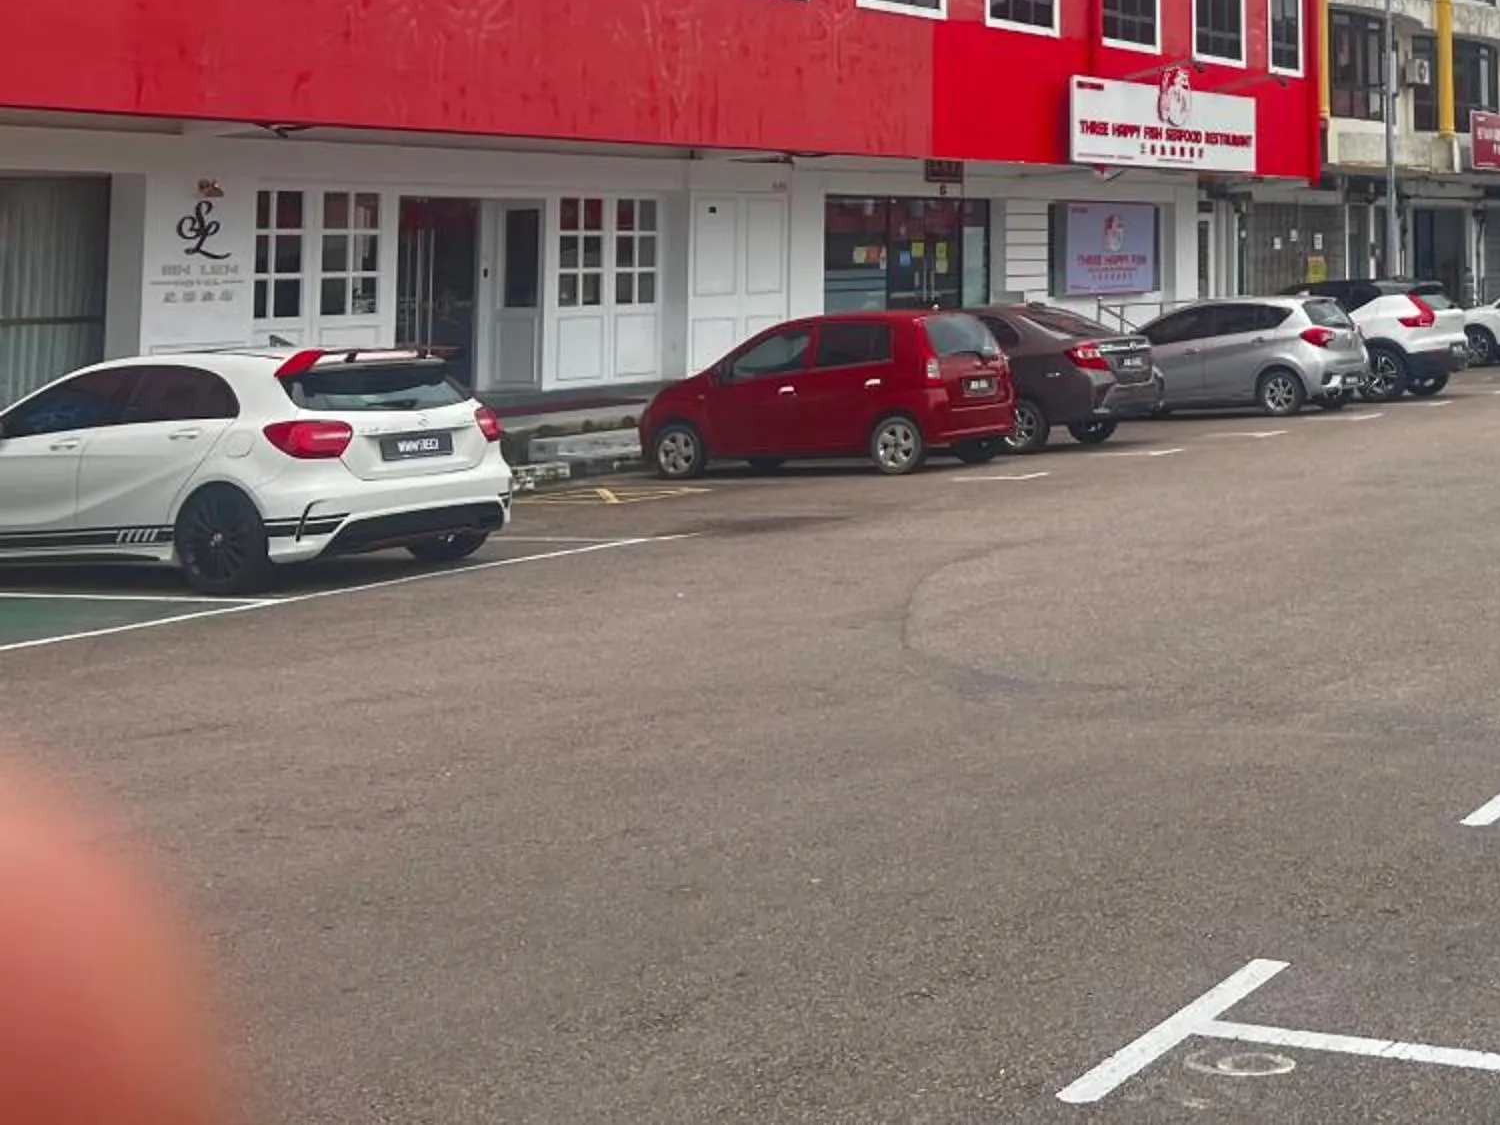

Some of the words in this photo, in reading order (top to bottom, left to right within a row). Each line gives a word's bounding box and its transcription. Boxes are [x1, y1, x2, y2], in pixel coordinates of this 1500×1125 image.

[1079, 120, 1109, 136] THREE
[1112, 123, 1141, 139] HAPPY
[1144, 126, 1163, 141] FISH
[1165, 128, 1202, 144] SEAFOOD
